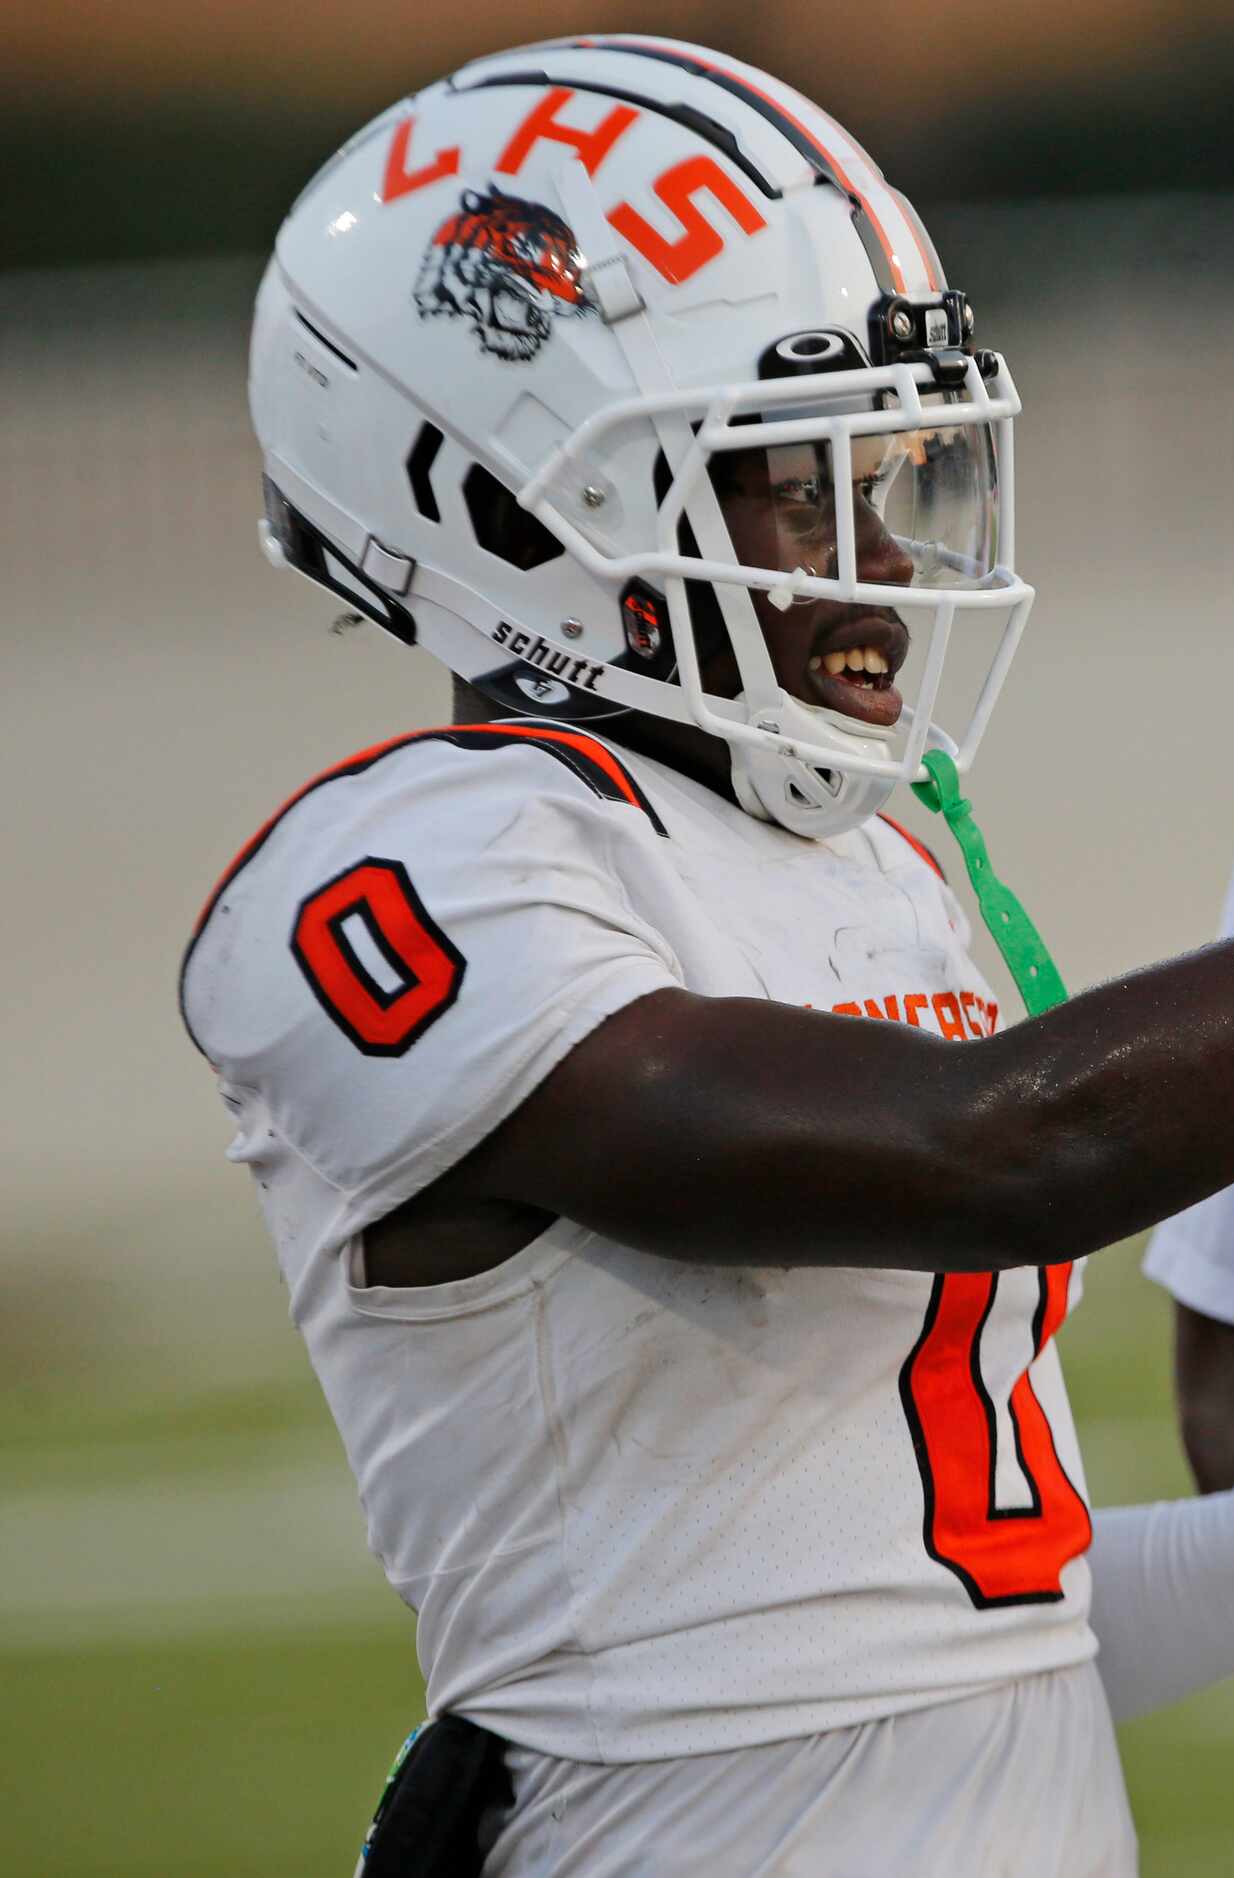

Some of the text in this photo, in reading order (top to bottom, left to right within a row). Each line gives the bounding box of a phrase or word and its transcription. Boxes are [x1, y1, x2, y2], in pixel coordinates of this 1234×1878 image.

[381, 85, 769, 285] LHS
[491, 620, 605, 691] schutt
[289, 856, 467, 1058] 0
